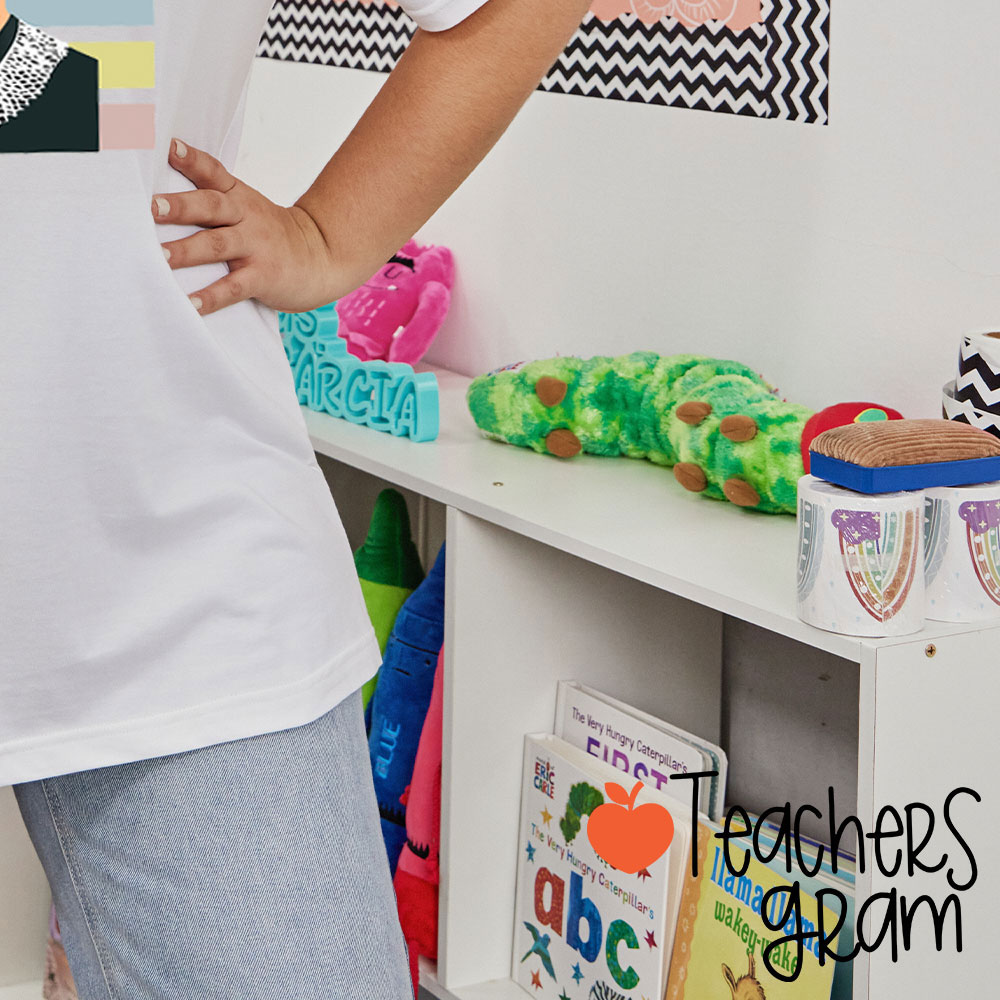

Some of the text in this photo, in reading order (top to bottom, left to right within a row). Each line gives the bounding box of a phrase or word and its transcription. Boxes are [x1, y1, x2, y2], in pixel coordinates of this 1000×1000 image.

[375, 716, 401, 779] BLUE
[572, 706, 689, 775] The Very Hungry Caterpillar's
[534, 761, 555, 786] ERIC
[534, 775, 555, 800] CARLE
[531, 823, 655, 920] The Very Hungry Caterpillar's
